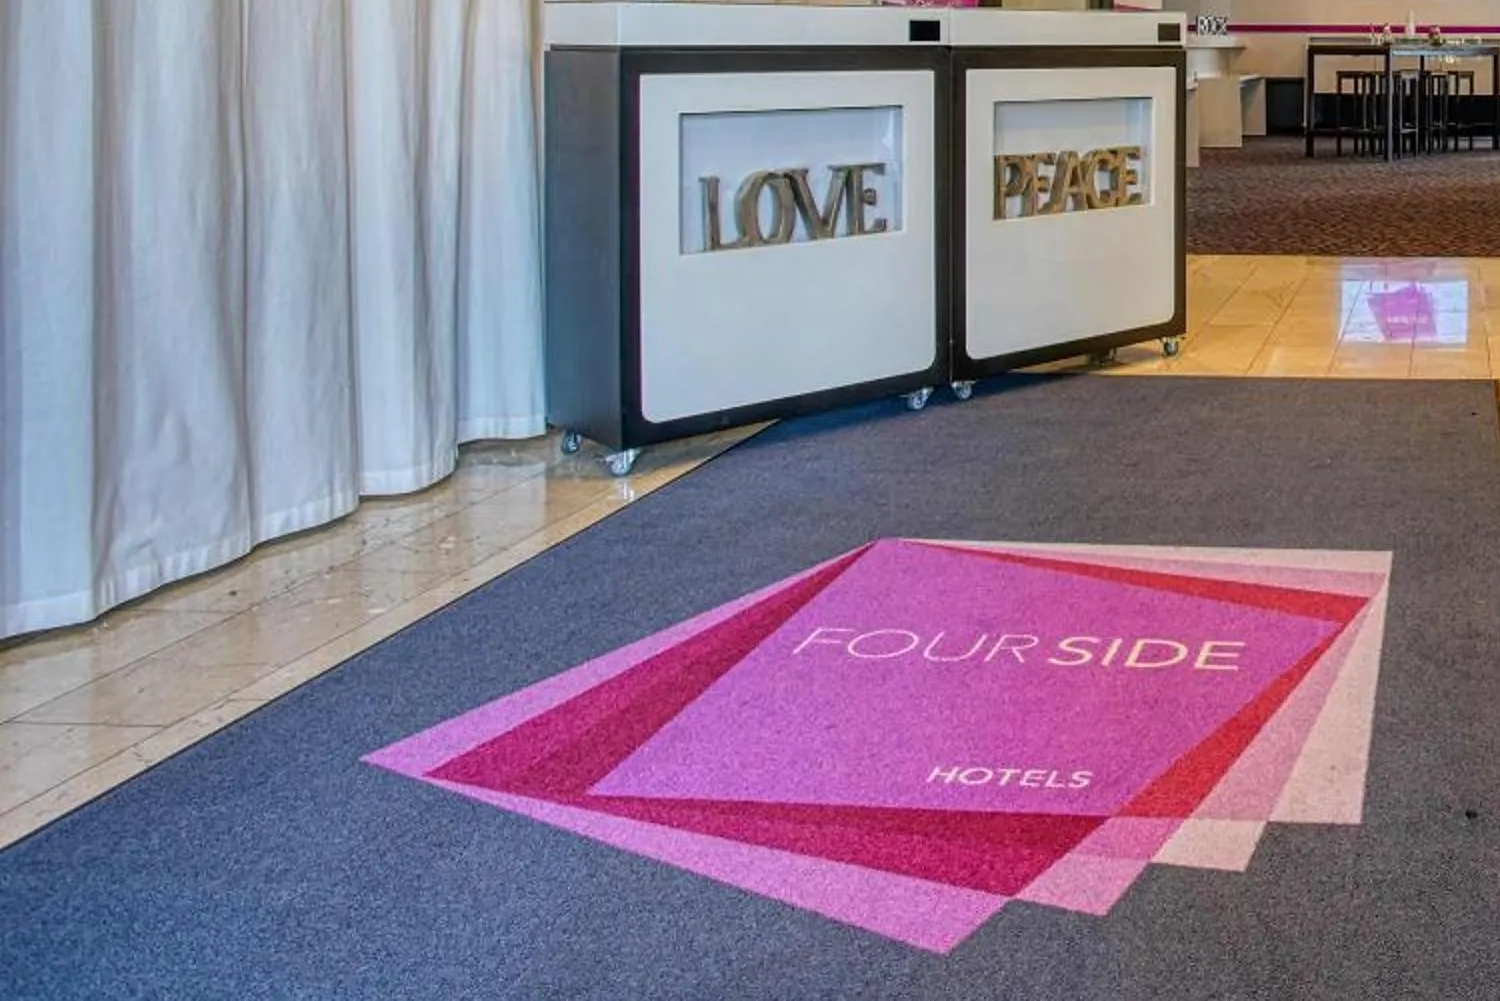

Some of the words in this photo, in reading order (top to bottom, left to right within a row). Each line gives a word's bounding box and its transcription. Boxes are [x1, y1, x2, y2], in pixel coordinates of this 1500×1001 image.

[699, 162, 887, 252] LOVE
[993, 146, 1142, 221] PEACE
[792, 627, 1040, 664] FOUR
[1048, 635, 1247, 672] SIDE
[926, 765, 1094, 789] HOTELS
